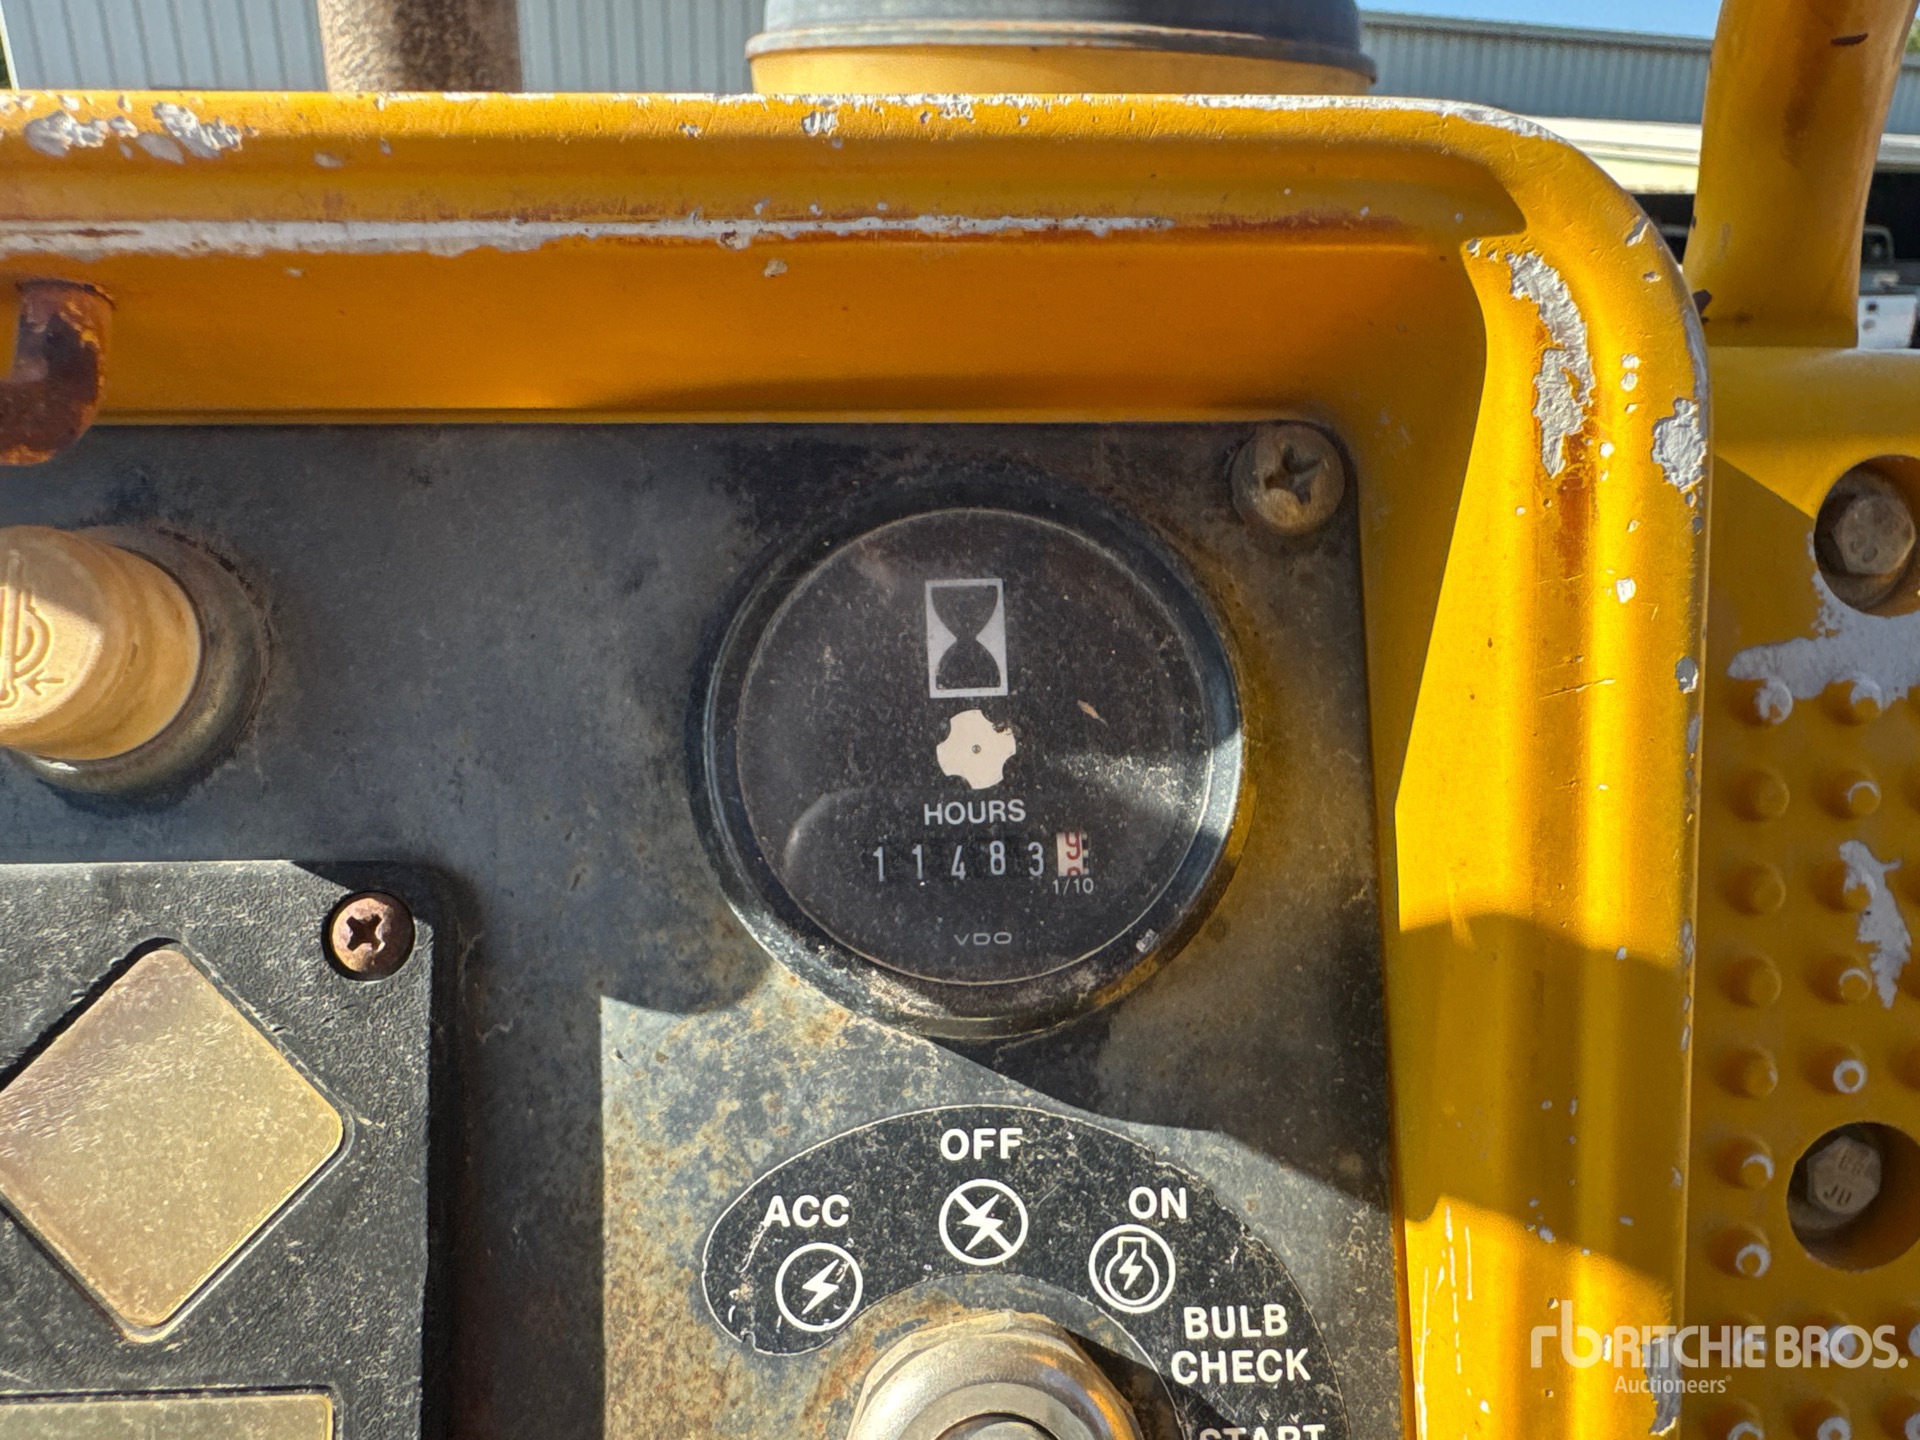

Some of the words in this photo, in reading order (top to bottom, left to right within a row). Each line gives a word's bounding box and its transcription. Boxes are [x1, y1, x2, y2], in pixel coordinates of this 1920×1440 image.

[924, 799, 1026, 825] HOURS
[1052, 878, 1094, 895] 1/10
[954, 932, 1012, 945] VDO
[940, 1128, 1023, 1160] OFF
[763, 1195, 850, 1227] ACC
[1128, 1187, 1188, 1220] ON
[1184, 1304, 1288, 1339] BULB
[1171, 1348, 1311, 1385] CHECK
